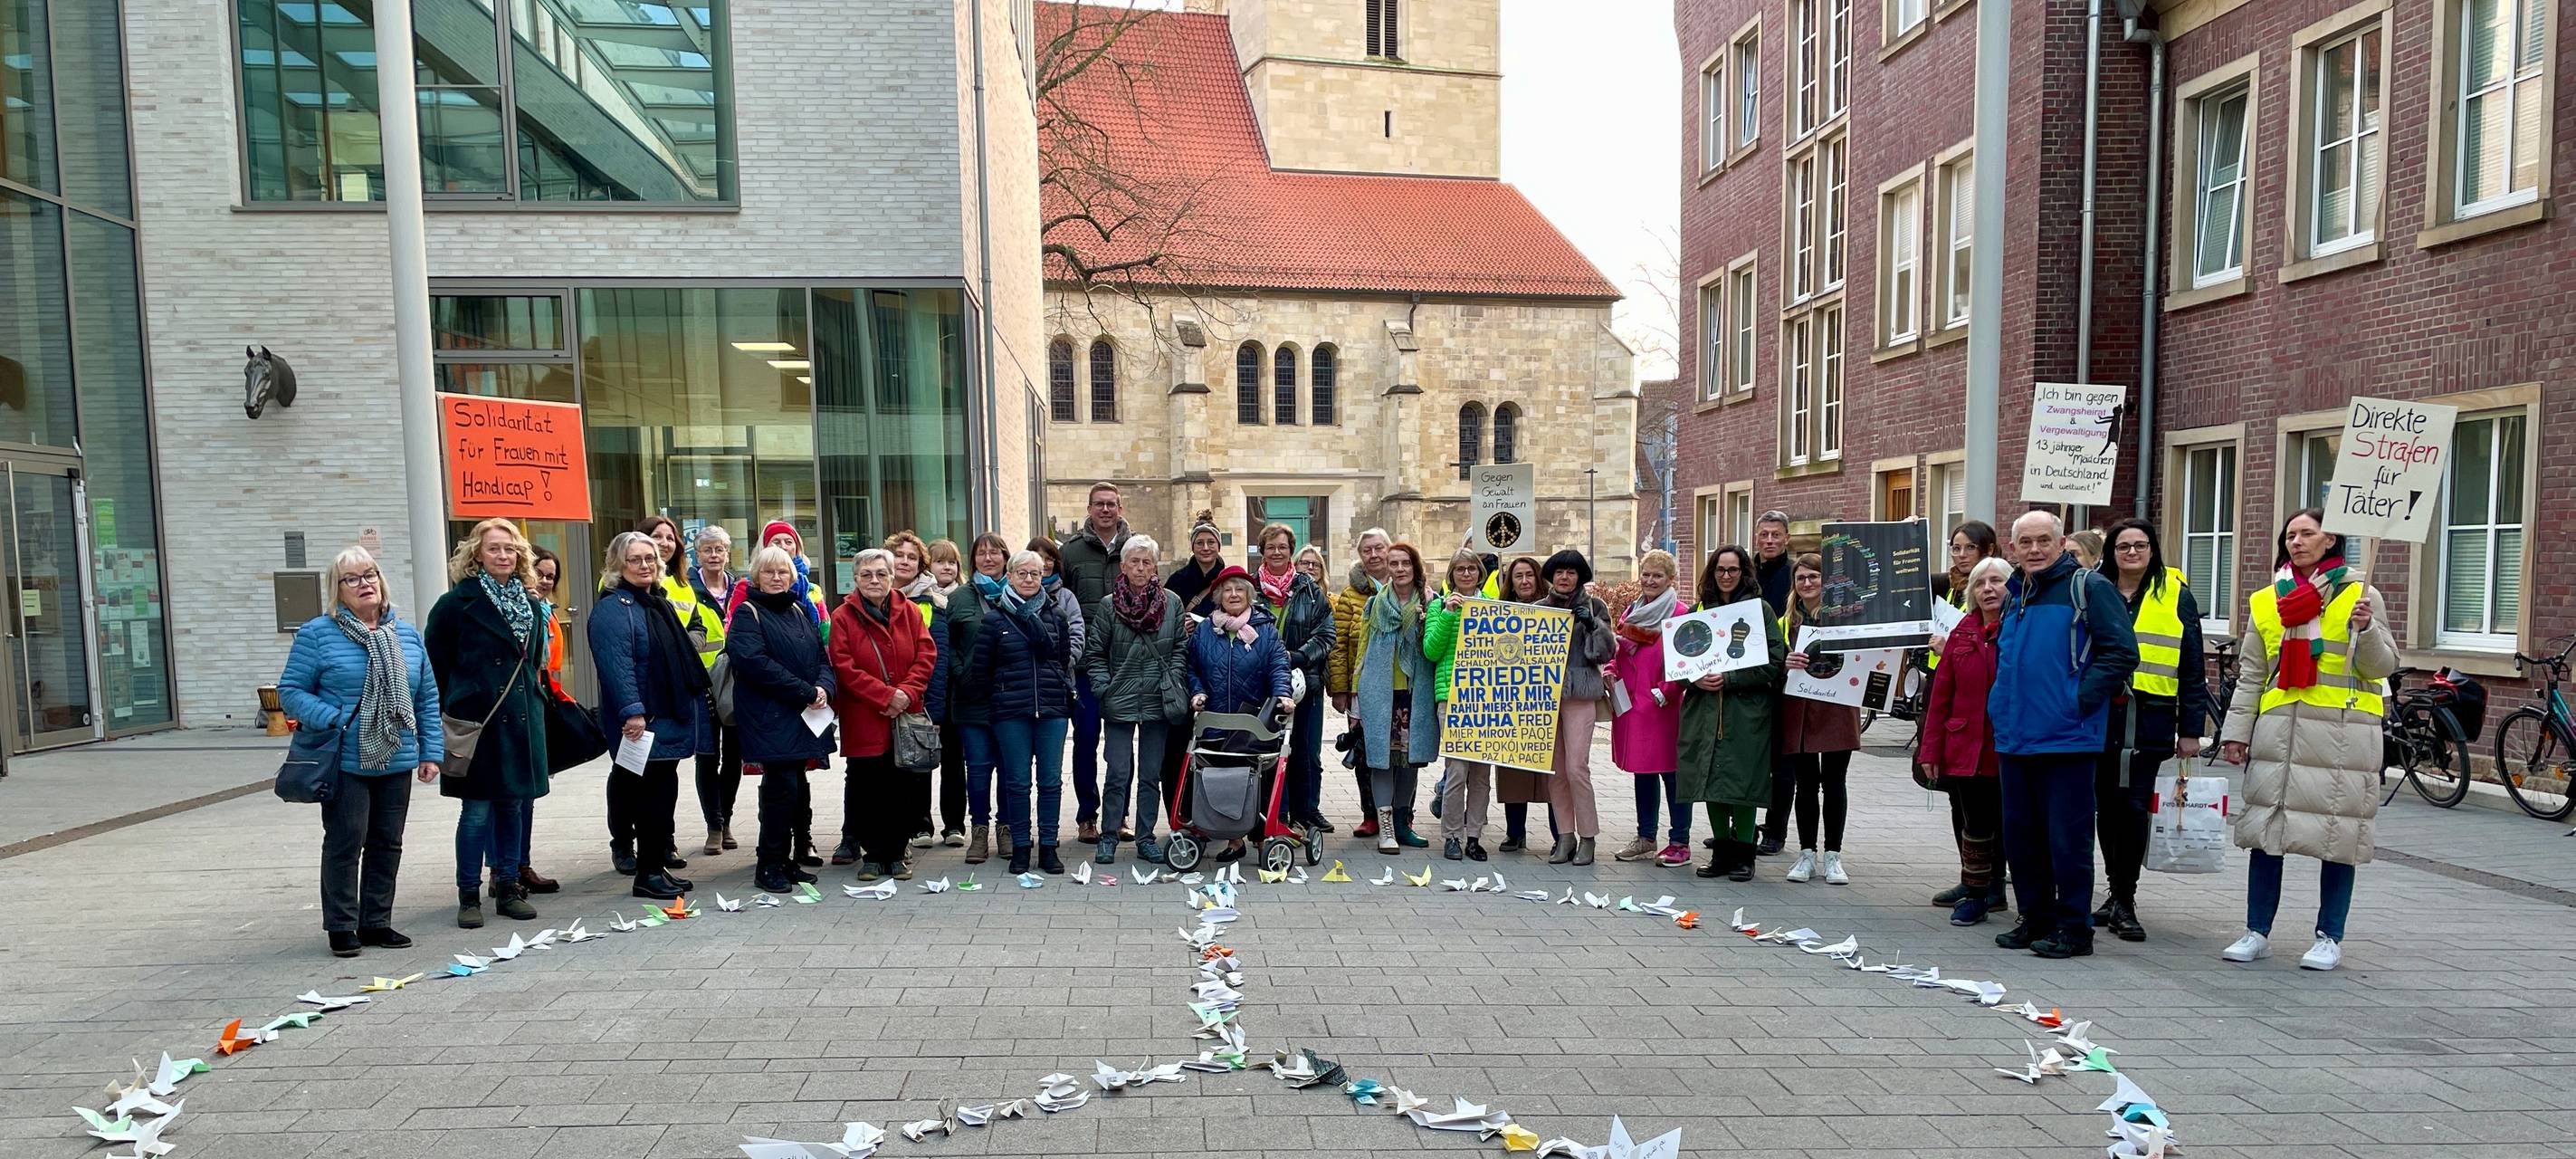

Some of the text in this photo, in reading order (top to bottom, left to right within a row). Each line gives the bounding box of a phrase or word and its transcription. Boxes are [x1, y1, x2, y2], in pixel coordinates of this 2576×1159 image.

[2065, 388, 2082, 402] bin
[2086, 393, 2118, 406] gegen
[454, 402, 554, 434] Solidarität
[2046, 406, 2106, 417] Zwangsheirat
[2352, 403, 2427, 434] Direkte
[2040, 426, 2108, 438] Vergewaltigung
[459, 437, 568, 465] für Frauen mit
[2036, 439, 2048, 451] 13
[2352, 431, 2439, 473] Strafen
[1481, 471, 1513, 487] Gegen
[2030, 464, 2109, 480] in Deutschland
[2373, 465, 2402, 490] für
[463, 471, 534, 501] Handicap
[1482, 485, 1514, 497] Gewalt
[2040, 482, 2054, 490] und
[1483, 498, 1527, 510] an Frauen
[1512, 608, 1536, 616] EIRINI
[1464, 616, 1570, 636] PACO PAIX
[1523, 633, 1567, 644] PEACE
[1524, 645, 1567, 656] HEIWA
[1455, 659, 1498, 667] SCHALOM
[1455, 665, 1560, 687] FRIEDEN
[1457, 685, 1553, 703] MIR MIR MIR
[1451, 704, 1479, 714] RAHU
[1483, 702, 1513, 713] MIERS
[1447, 714, 1552, 728] RAUHA FRED
[1449, 729, 1474, 739] MIER
[1521, 727, 1554, 741] PAQE
[1445, 739, 1483, 752] BÉKE
[1521, 742, 1552, 752] VREDE
[1482, 752, 1545, 764] PAZ LA PACE
